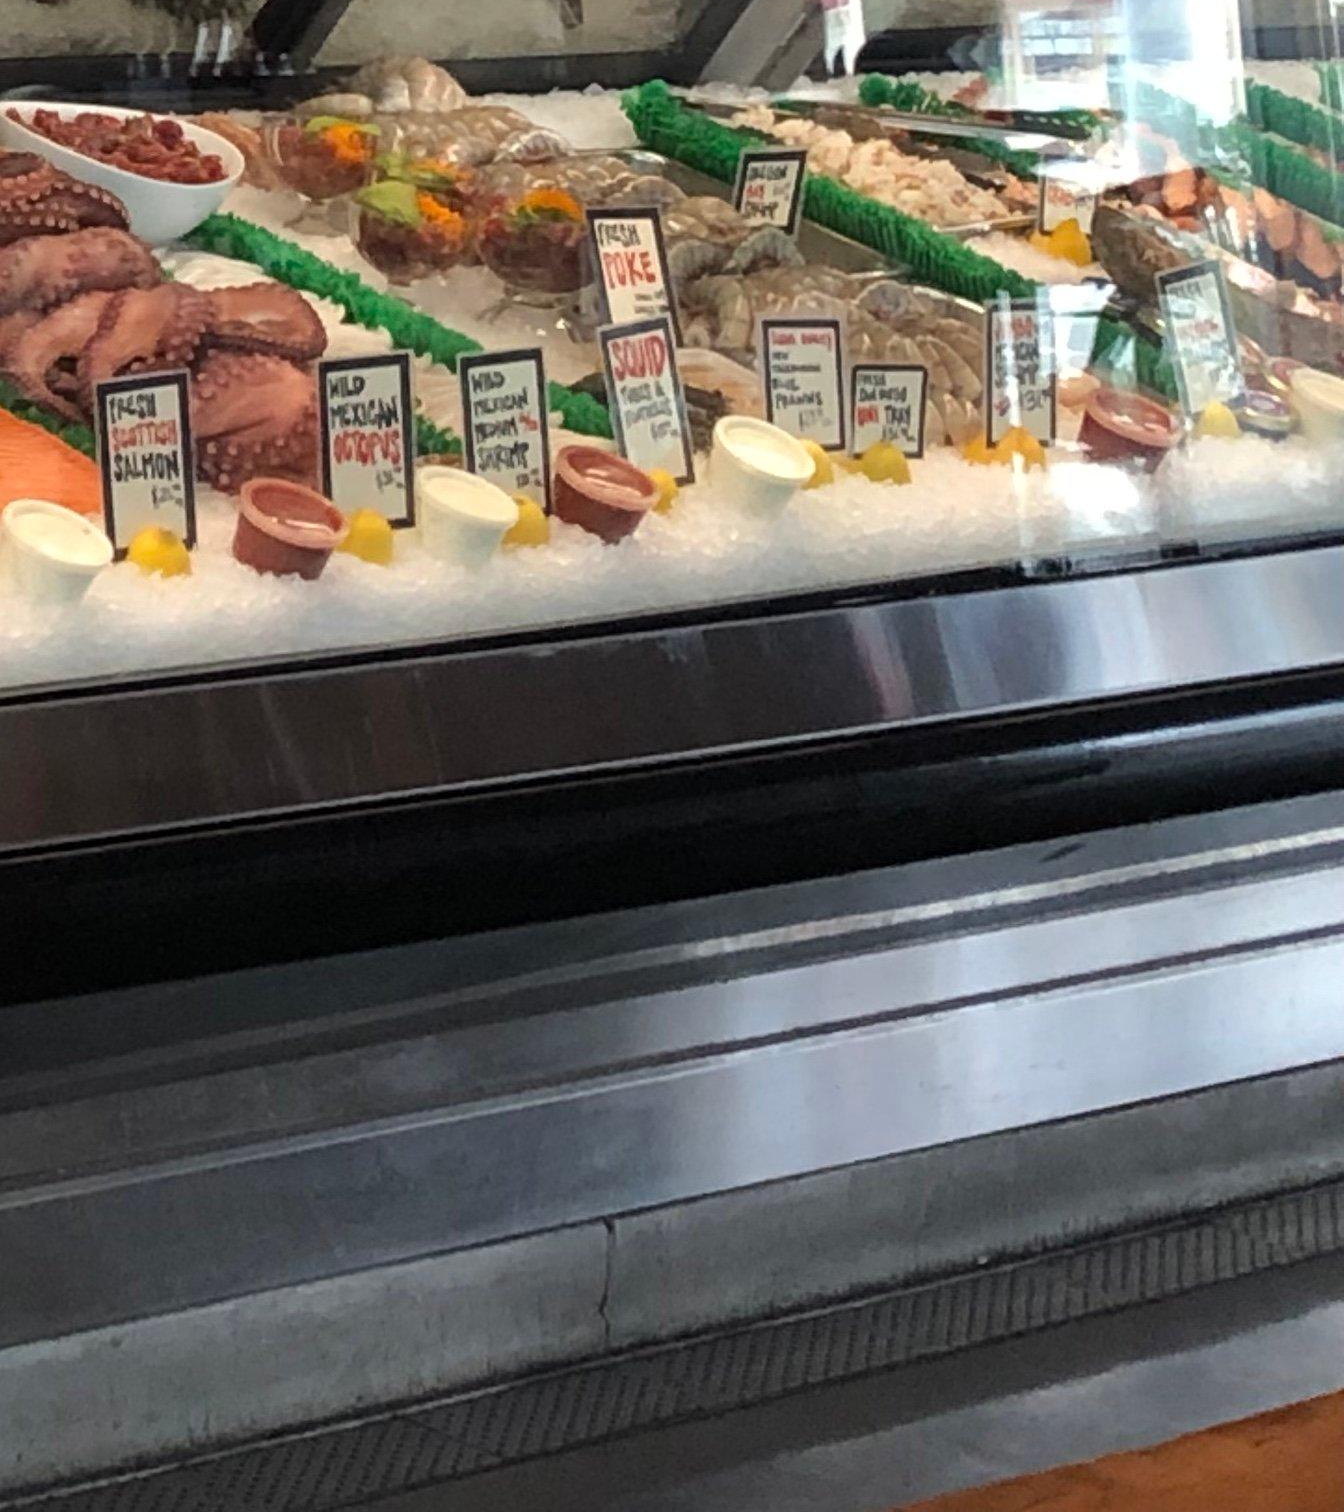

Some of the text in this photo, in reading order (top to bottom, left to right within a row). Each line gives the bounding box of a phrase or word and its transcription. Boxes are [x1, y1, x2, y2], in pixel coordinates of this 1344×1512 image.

[597, 222, 641, 247] FRESH
[602, 251, 656, 290] POKE
[611, 335, 666, 382] SQUID
[329, 375, 366, 399] WILD
[471, 371, 506, 393] WILD
[109, 392, 157, 424] FRESH
[330, 395, 399, 430] MEXICAN
[112, 419, 178, 453] SCOTTISH
[333, 430, 401, 466] OCTOPUS
[114, 450, 180, 483] SALMON
